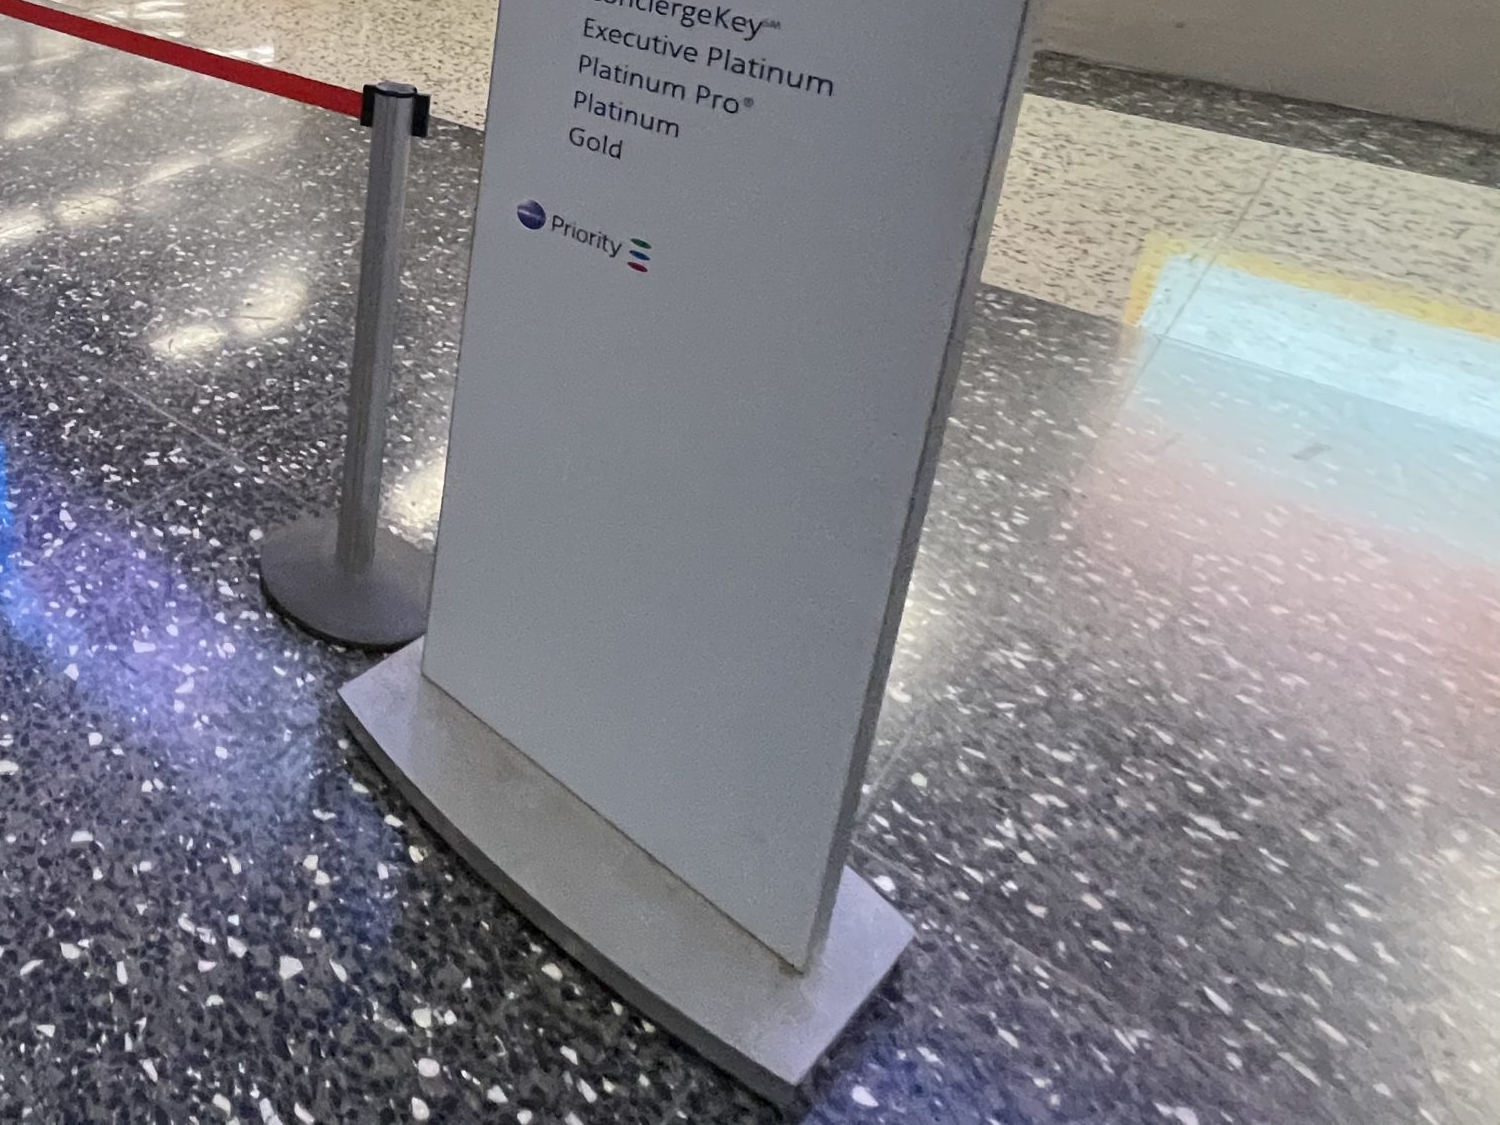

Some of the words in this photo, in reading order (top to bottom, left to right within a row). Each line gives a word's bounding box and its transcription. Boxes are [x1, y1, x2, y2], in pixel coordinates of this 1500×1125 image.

[578, 54, 686, 100] Platinum
[583, 17, 699, 63] Executive
[706, 45, 835, 97] Platinum
[573, 90, 680, 139] Platinum
[568, 127, 623, 159] Gold
[551, 214, 622, 258] Priority
